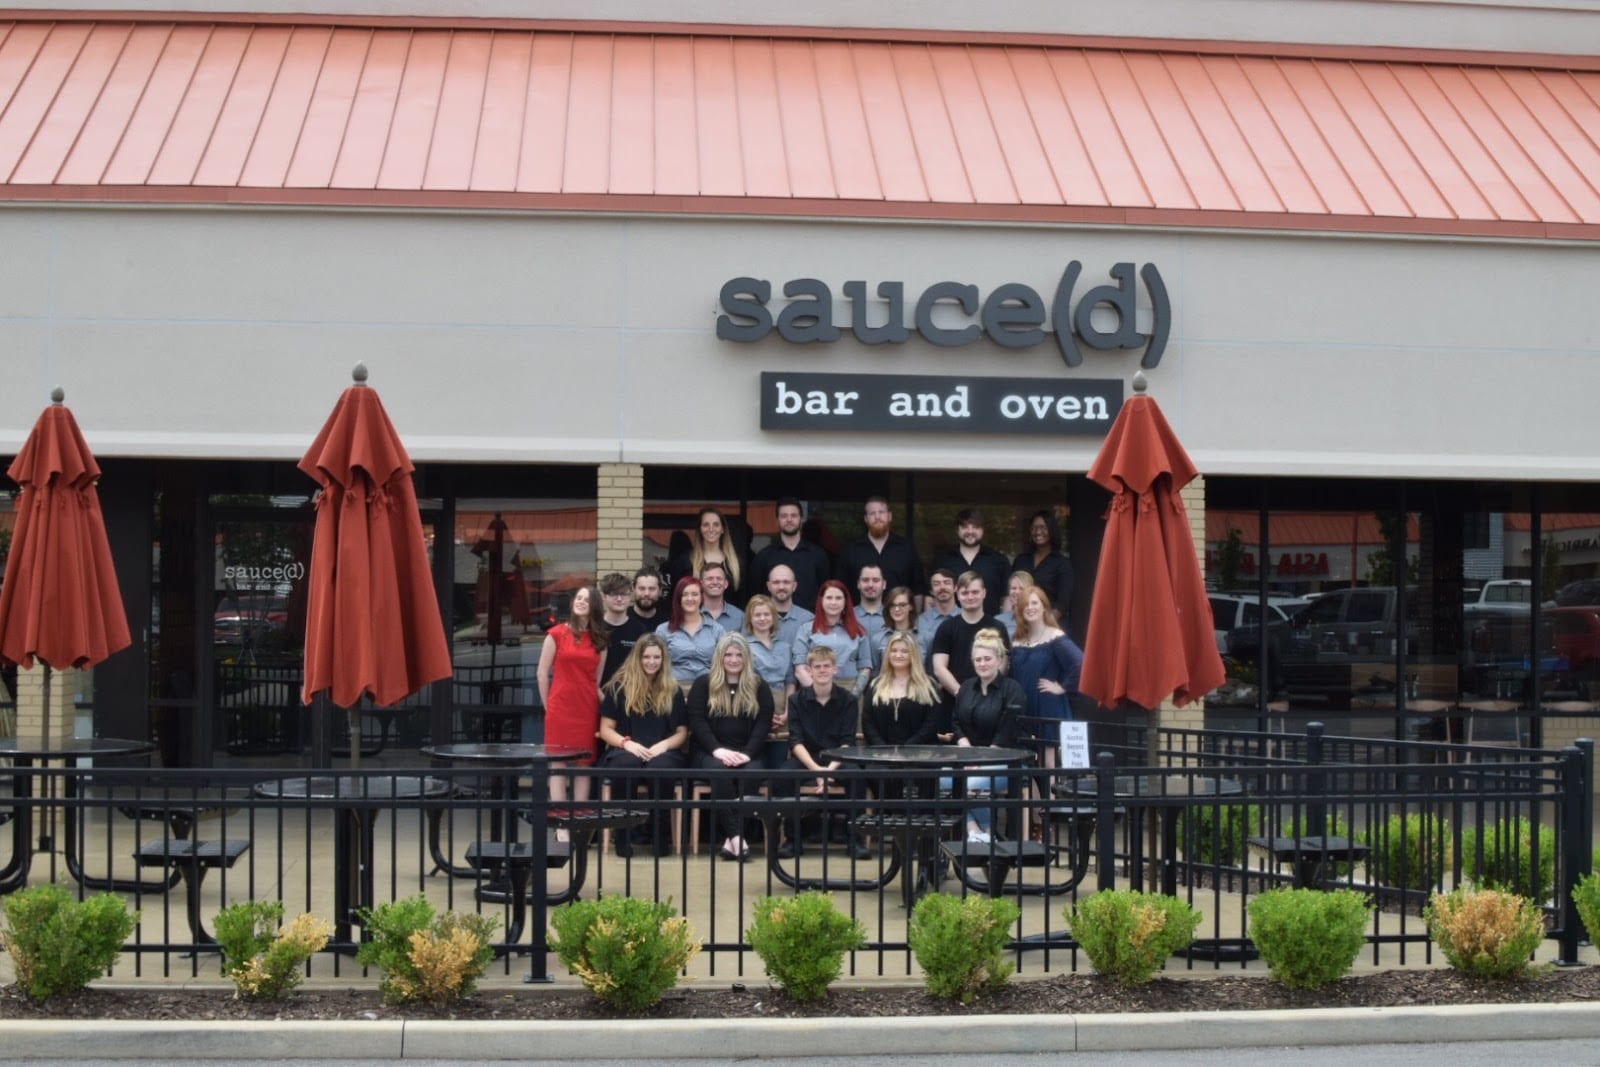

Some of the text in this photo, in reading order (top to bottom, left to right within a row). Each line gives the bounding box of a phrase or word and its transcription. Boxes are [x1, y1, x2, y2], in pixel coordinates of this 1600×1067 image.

[716, 260, 1171, 369] sauce(d)
[775, 382, 1109, 420] bar and oven
[225, 562, 304, 580] sauce(d)
